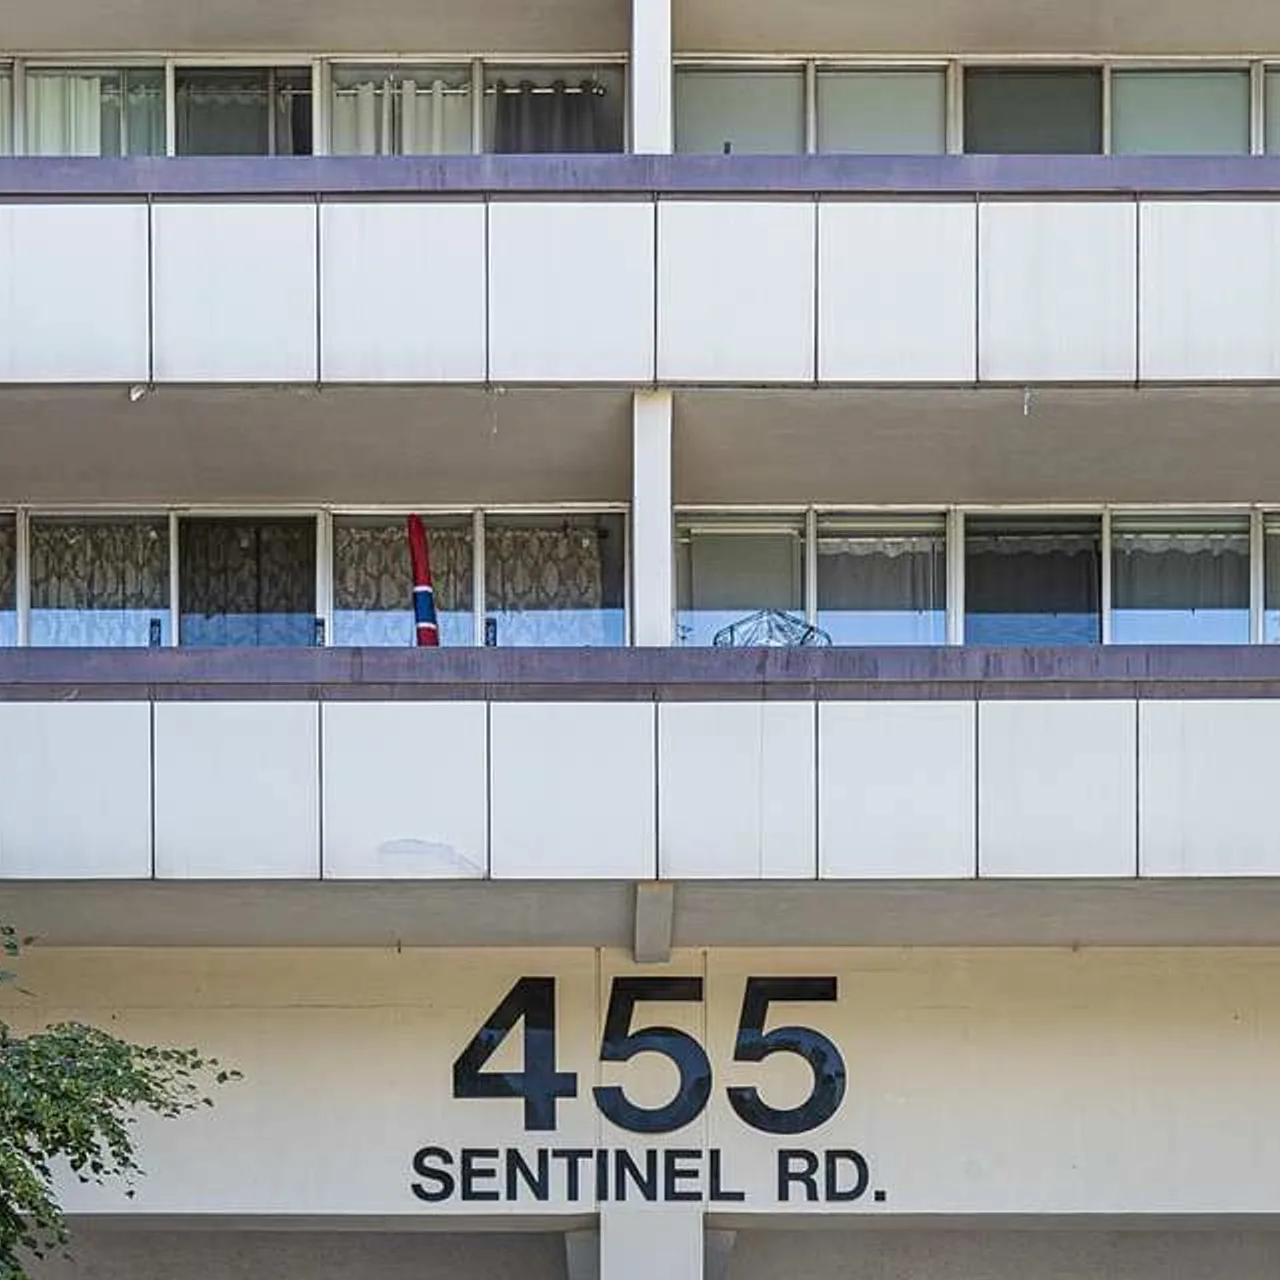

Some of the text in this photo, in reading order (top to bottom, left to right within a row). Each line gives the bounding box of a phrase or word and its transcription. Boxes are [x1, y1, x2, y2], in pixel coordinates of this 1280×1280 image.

[452, 976, 847, 1134] 455
[411, 1147, 886, 1201] SENTINEL RD.
